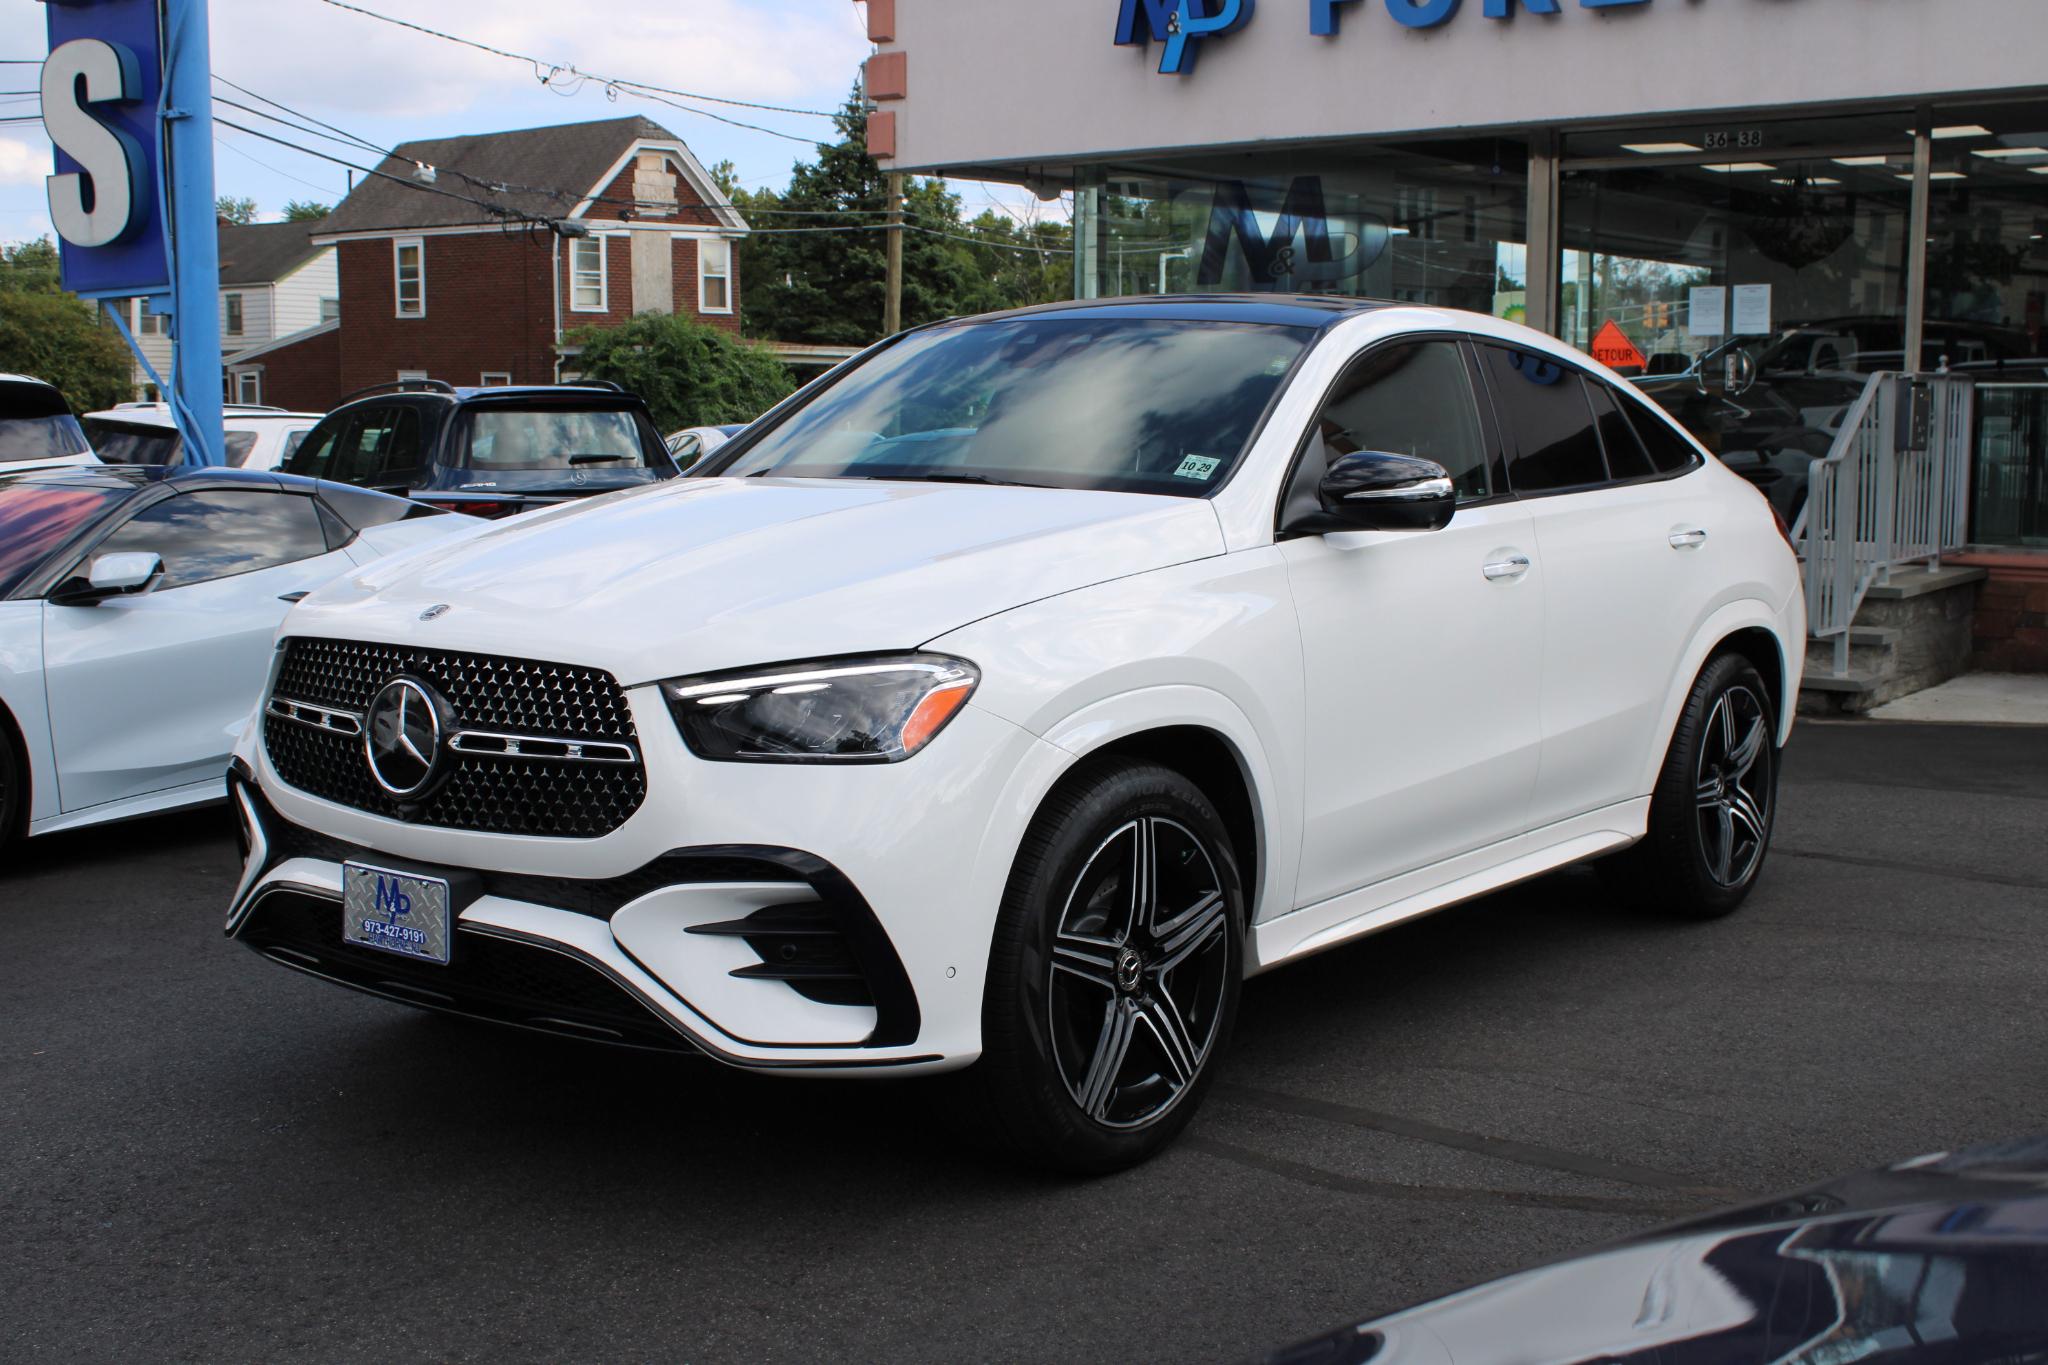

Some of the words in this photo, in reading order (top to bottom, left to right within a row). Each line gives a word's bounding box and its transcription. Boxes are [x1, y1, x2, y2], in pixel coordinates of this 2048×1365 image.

[1706, 131, 1761, 147] 36-38
[1181, 461, 1196, 471] 10
[1196, 463, 1212, 473] 29
[363, 920, 425, 944] 973-427-9191
